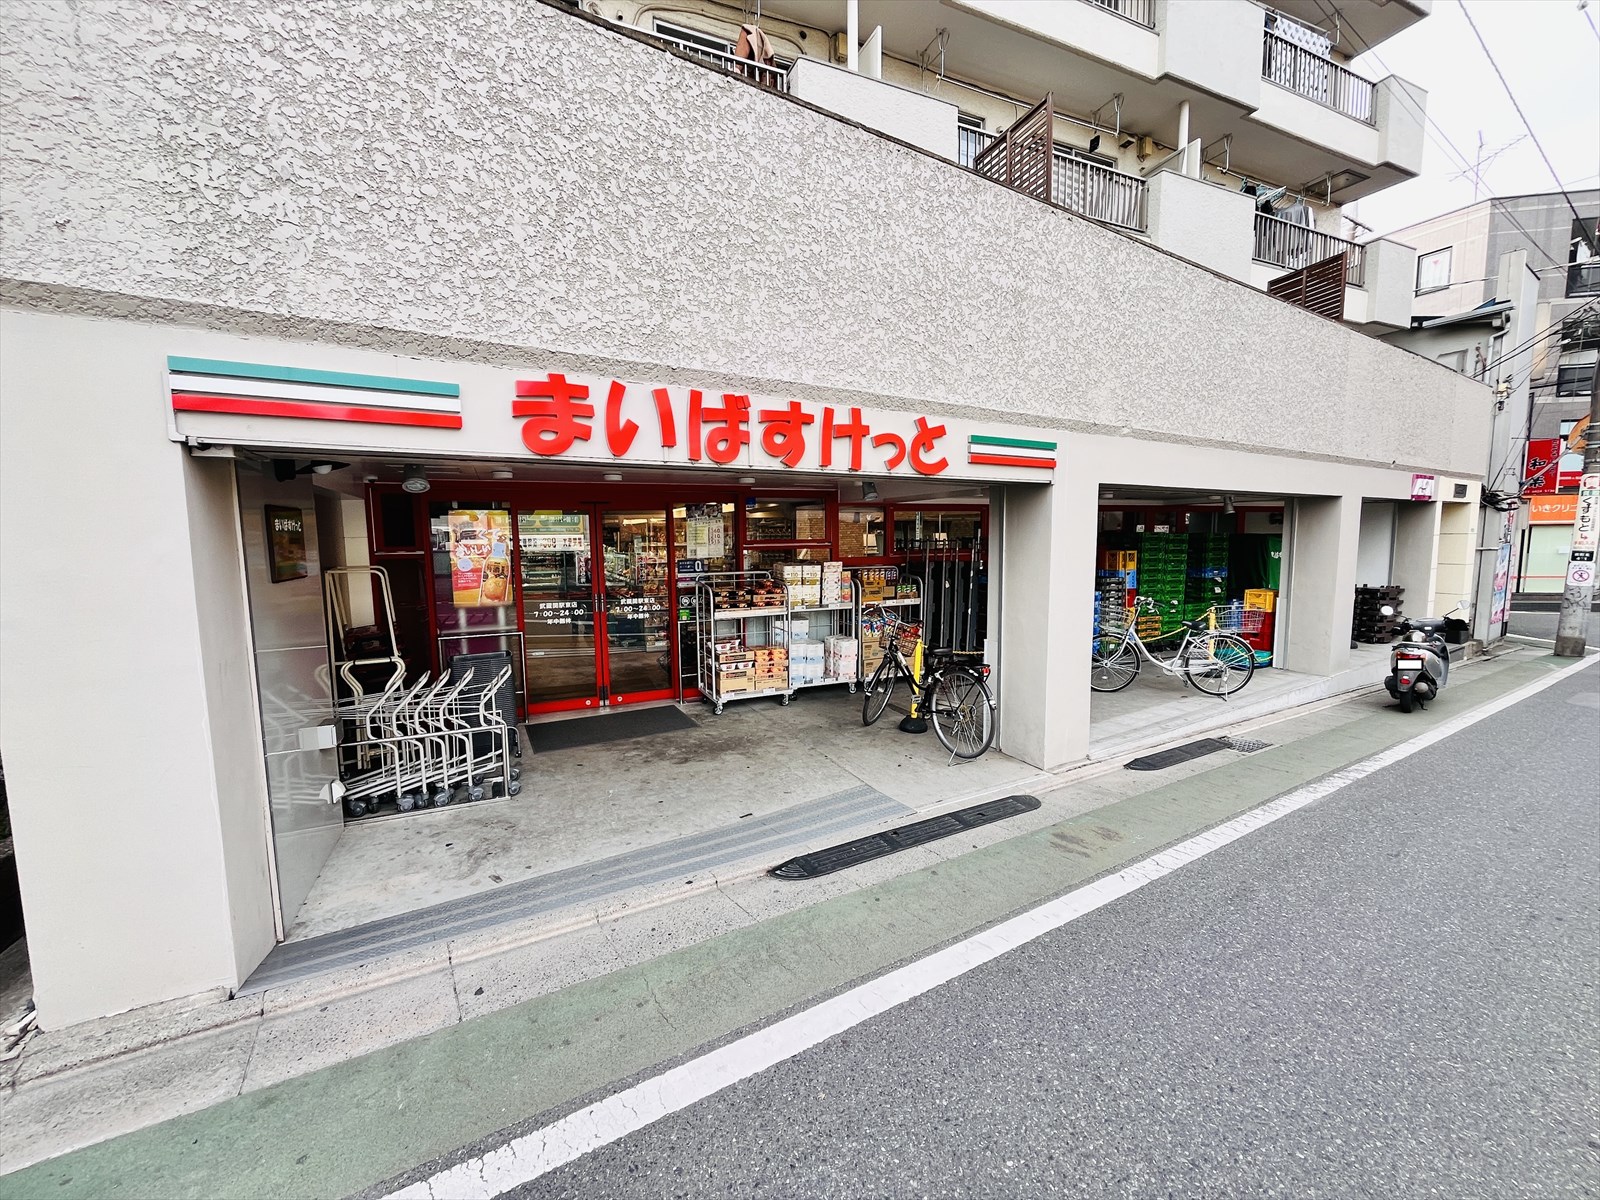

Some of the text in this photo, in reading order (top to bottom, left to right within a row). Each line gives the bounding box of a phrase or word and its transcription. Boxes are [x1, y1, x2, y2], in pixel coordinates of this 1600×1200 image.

[511, 373, 949, 476] まいばすけっと
[274, 518, 302, 531] まいばすけっと
[1578, 496, 1592, 532] くすもと
